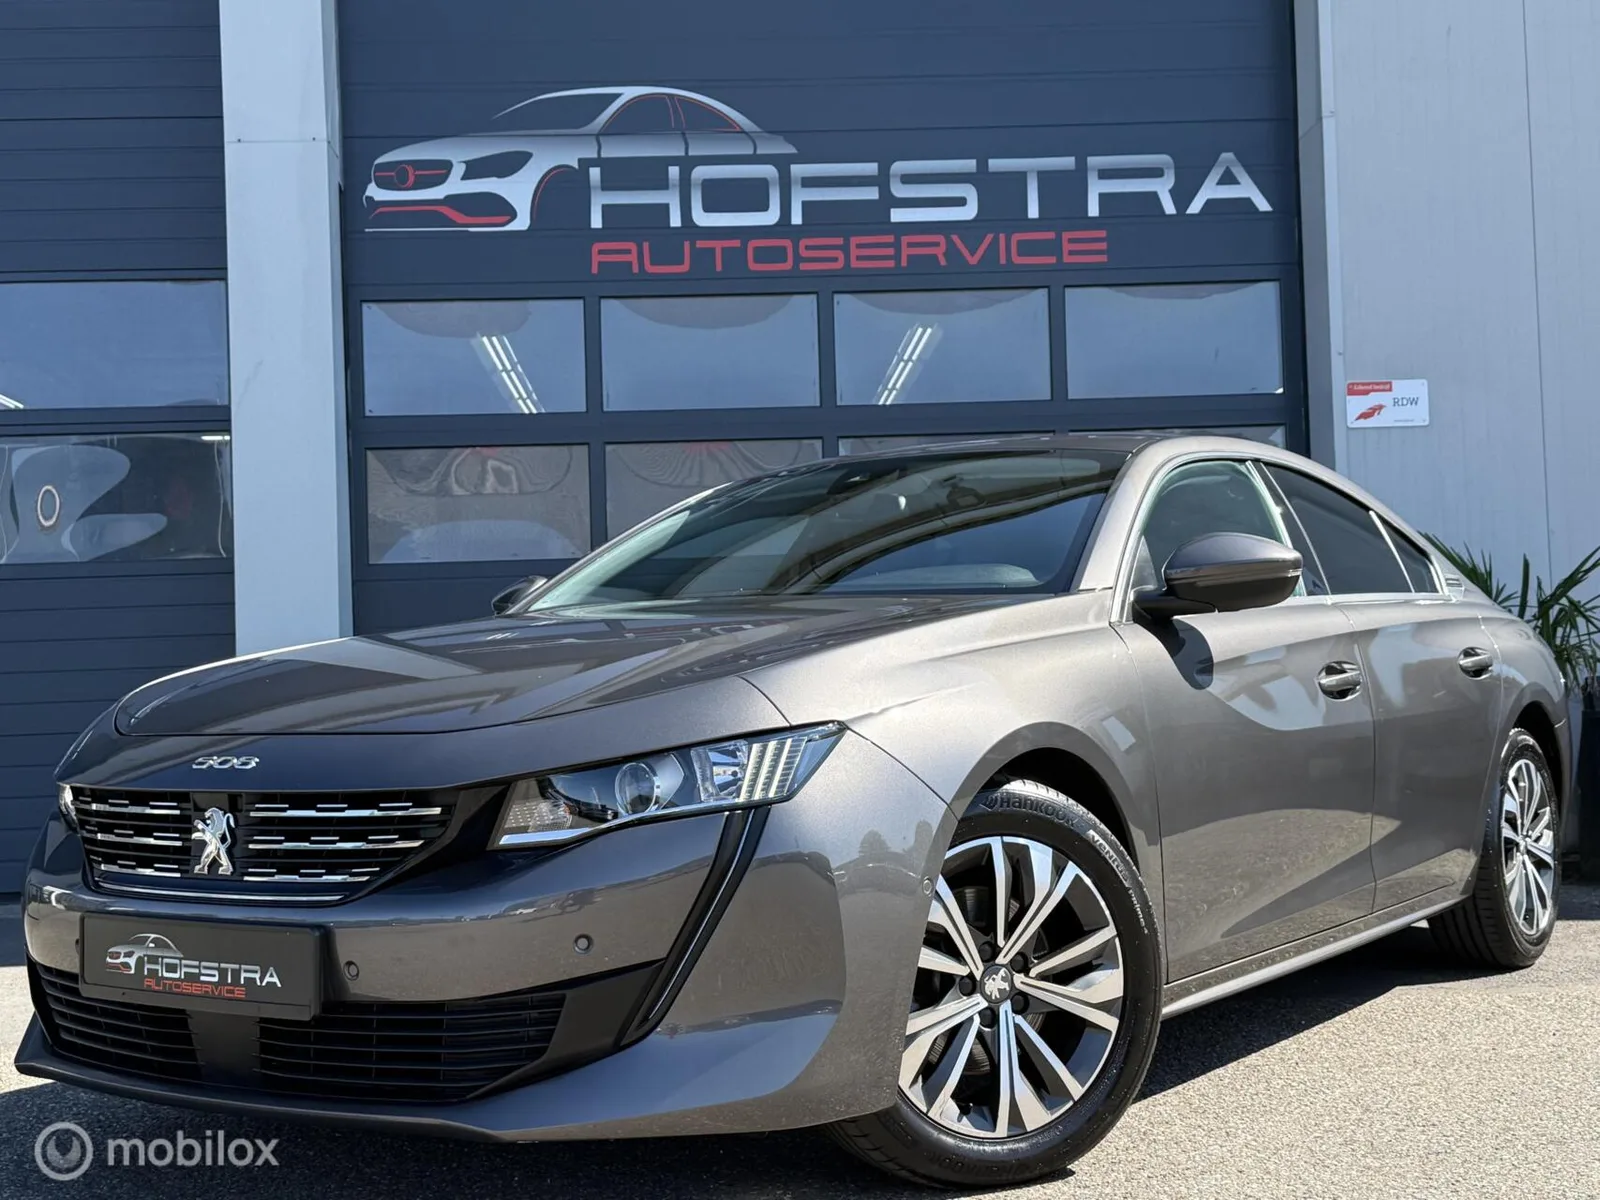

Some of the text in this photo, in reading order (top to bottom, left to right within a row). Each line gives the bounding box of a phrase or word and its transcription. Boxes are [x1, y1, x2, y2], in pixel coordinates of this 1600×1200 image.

[589, 151, 1273, 229] HOFSTRA
[591, 229, 1109, 275] AUTOSERVICE
[1392, 397, 1419, 407] RDW
[192, 756, 259, 769] 508
[144, 956, 282, 988] HOFSTRA
[144, 977, 246, 998] AUTOSERVICE
